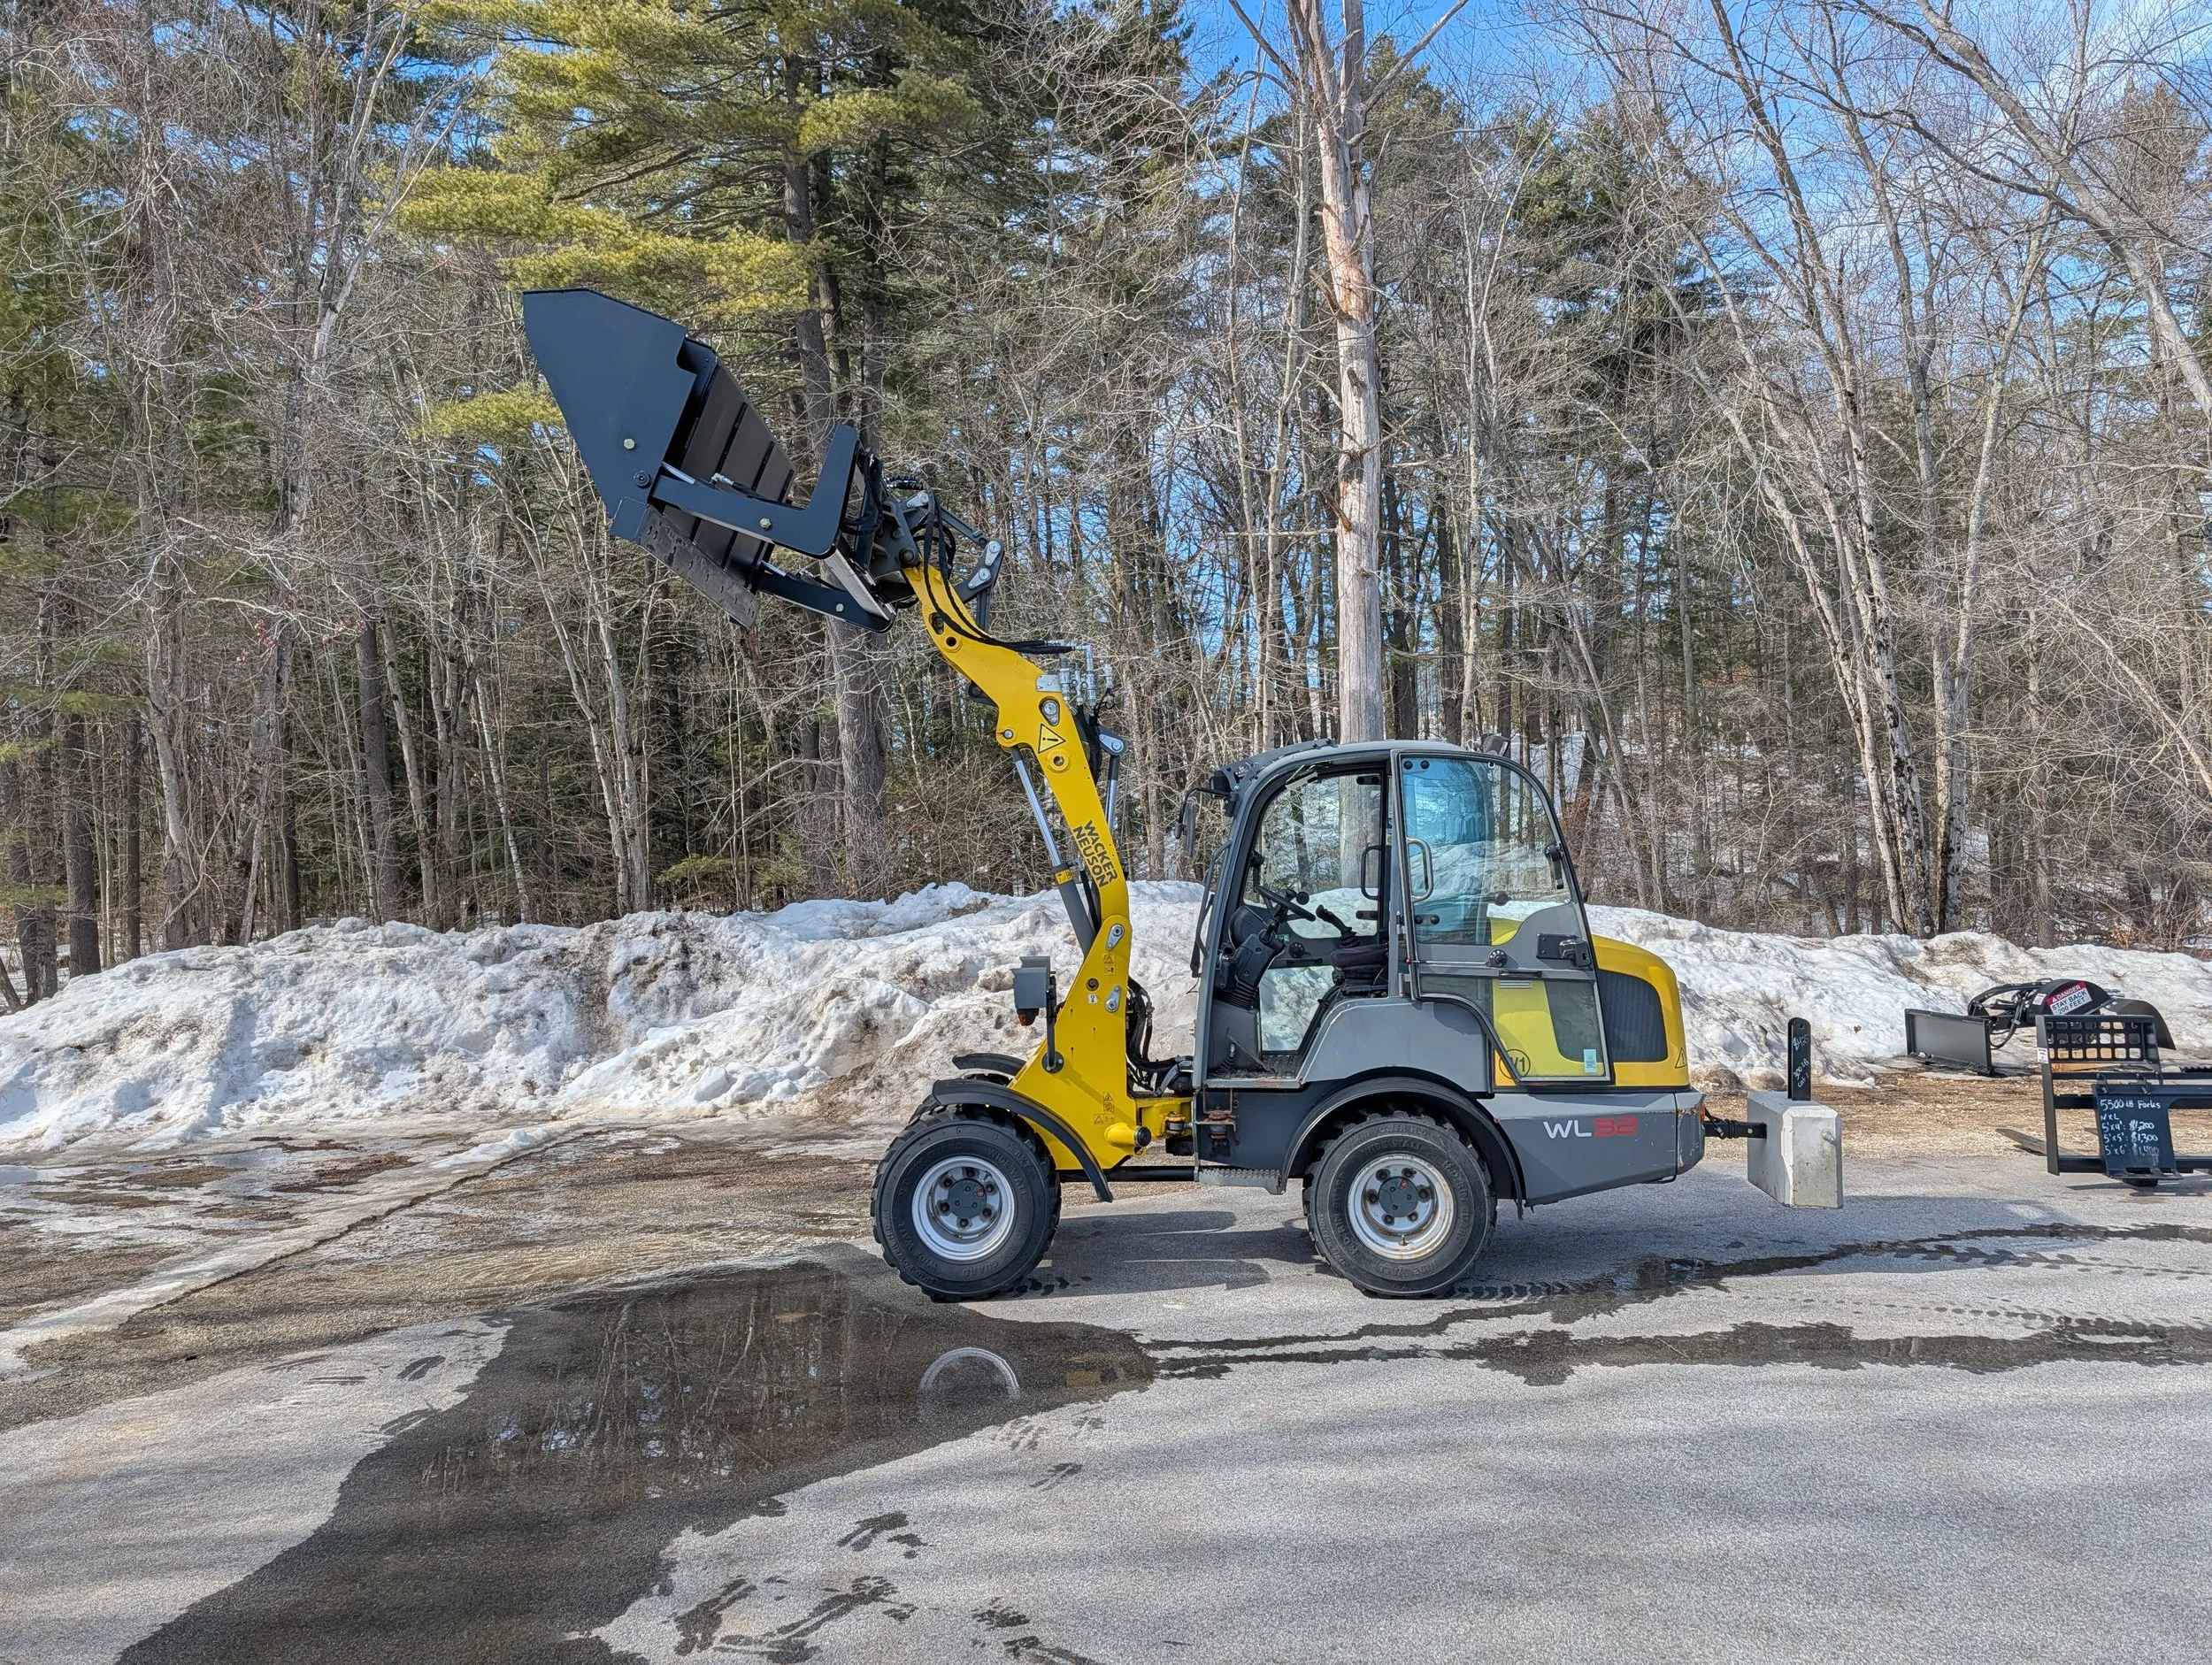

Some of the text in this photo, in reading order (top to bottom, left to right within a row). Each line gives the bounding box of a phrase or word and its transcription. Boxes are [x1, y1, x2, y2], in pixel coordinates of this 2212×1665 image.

[1072, 825, 1109, 888] NEUSON
[1085, 819, 1118, 883] WACKER
[2052, 999, 2068, 1010] STAY
[2068, 989, 2087, 1001] BACK
[2056, 985, 2081, 1000] DANGER
[2058, 997, 2085, 1015] 200 FEET
[2100, 1099, 2124, 1111] 5500
[2137, 1100, 2162, 1109] Forks
[2131, 1131, 2159, 1143] $1,300
